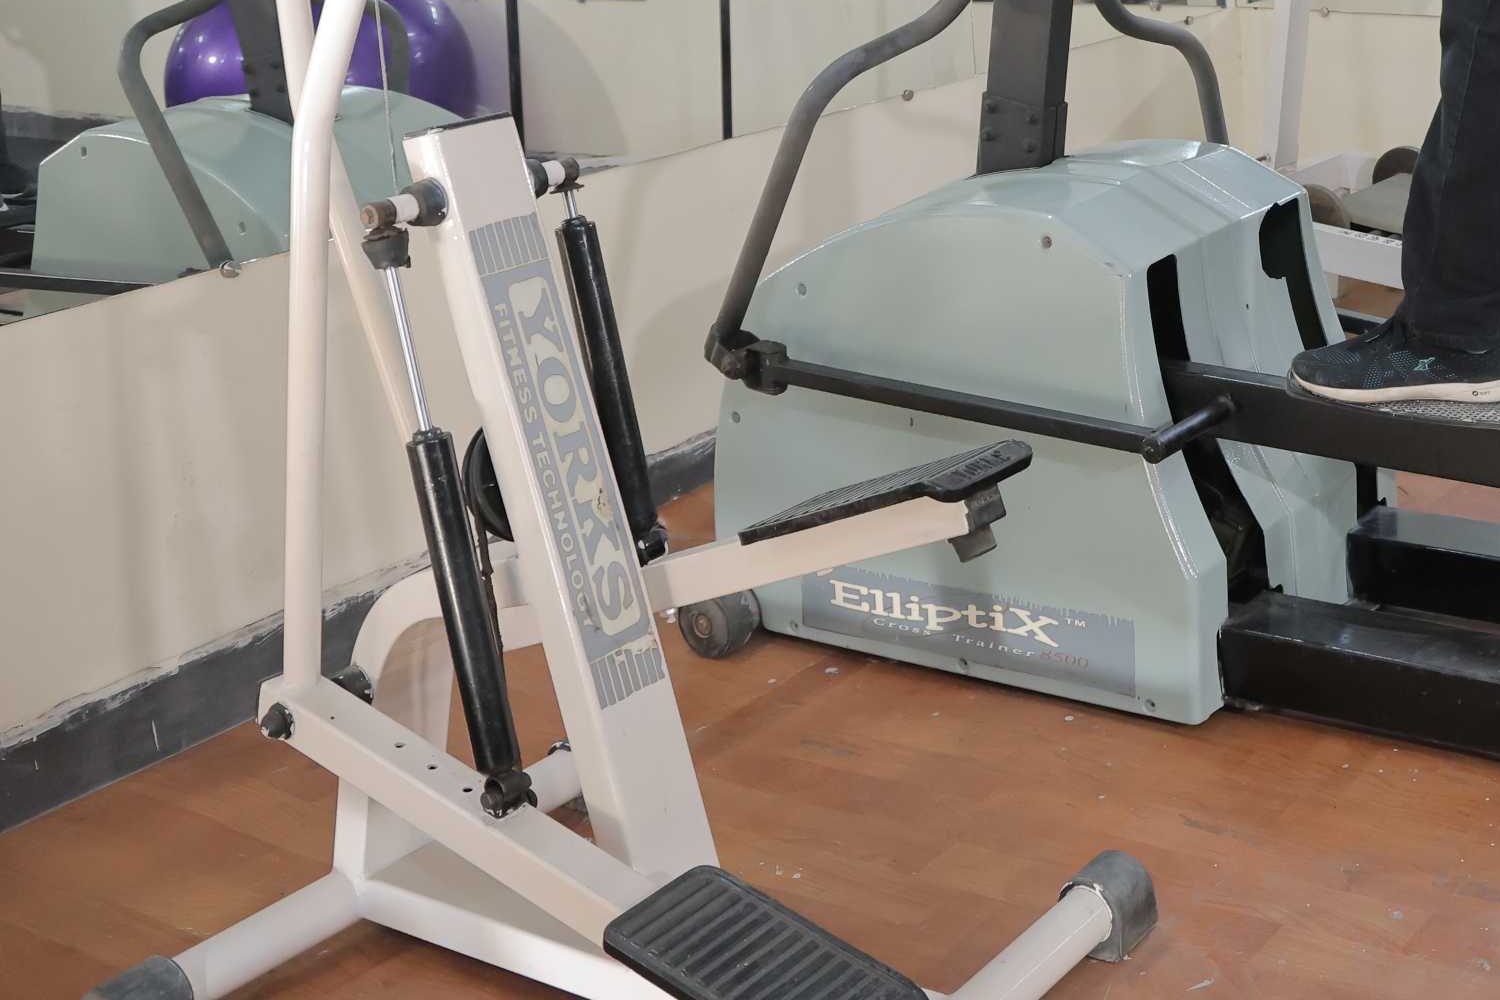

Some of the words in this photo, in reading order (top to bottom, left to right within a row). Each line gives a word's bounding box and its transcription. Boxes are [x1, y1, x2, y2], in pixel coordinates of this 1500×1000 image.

[495, 302, 537, 425] FITNESS
[529, 434, 600, 630] TECHNOLOGY
[518, 287, 635, 622] YORKS
[873, 617, 932, 636] Cross
[952, 633, 1036, 658] Trainer
